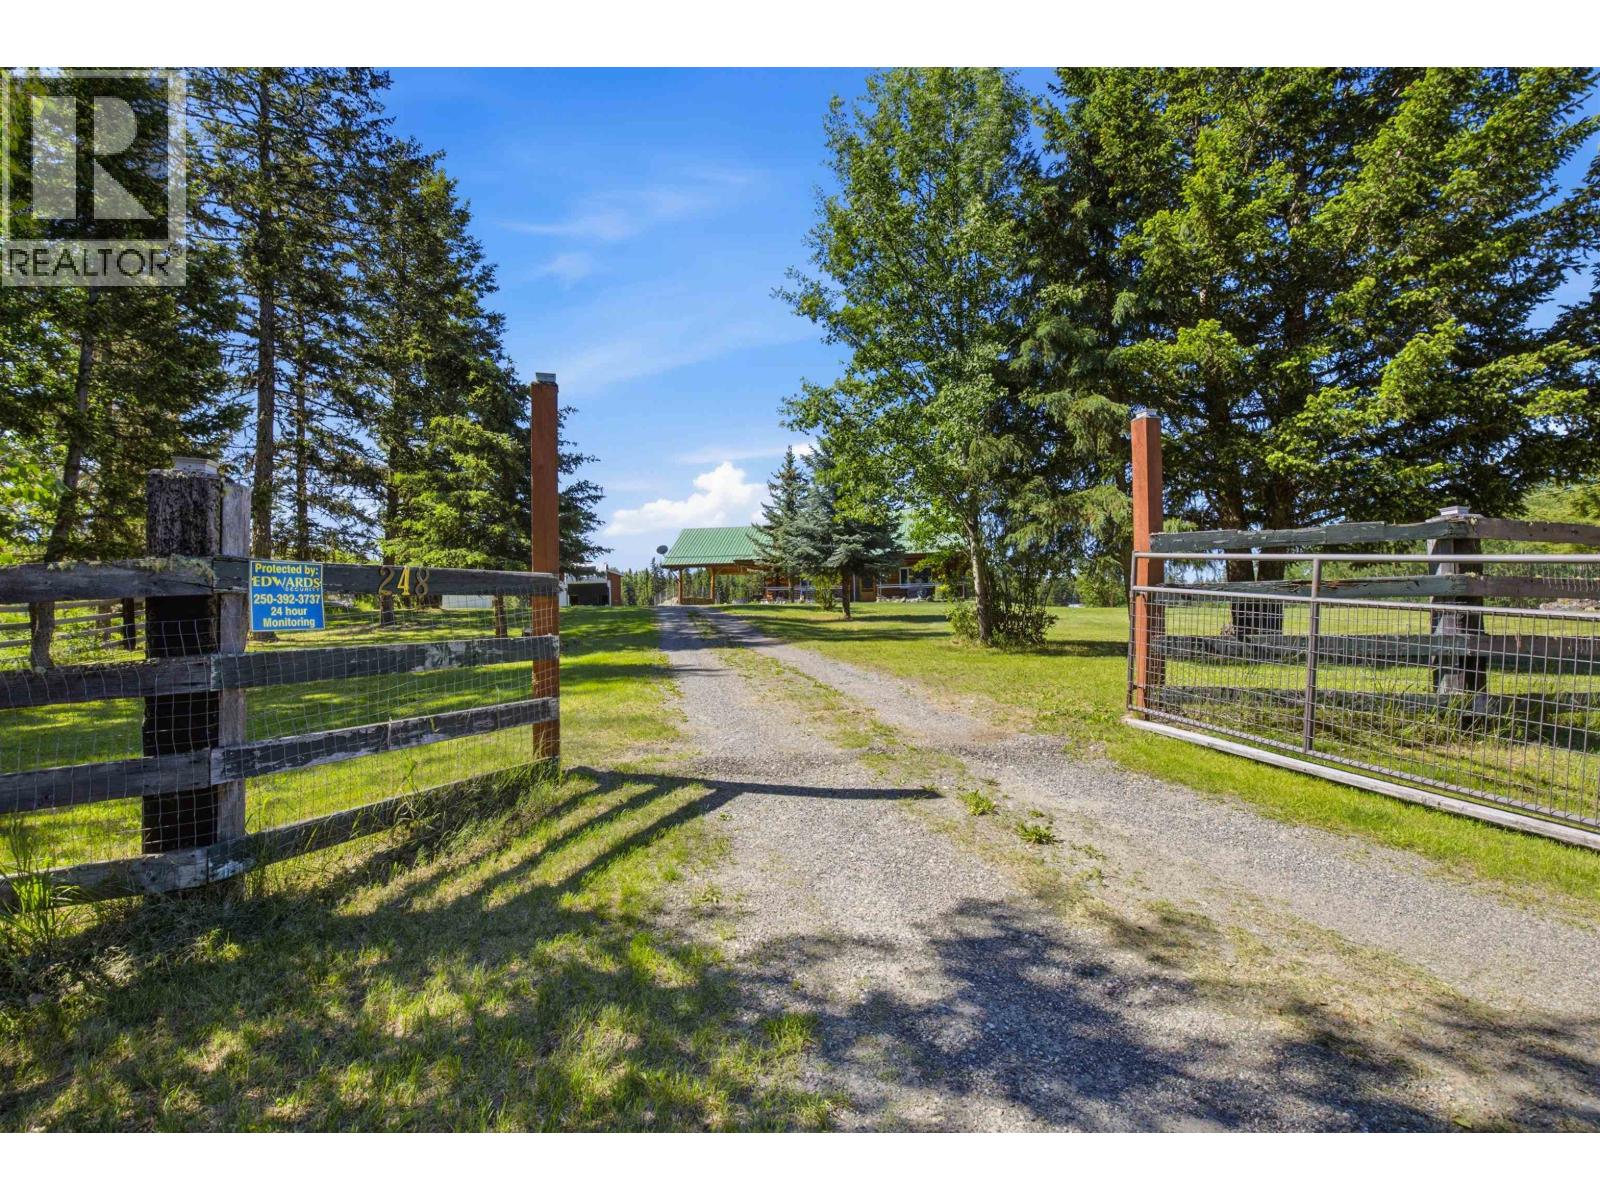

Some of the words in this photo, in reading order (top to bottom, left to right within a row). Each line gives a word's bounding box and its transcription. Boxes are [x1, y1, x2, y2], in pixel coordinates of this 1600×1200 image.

[255, 563, 302, 574] Protected
[304, 565, 319, 576] by:
[252, 576, 321, 589] EDWARDS
[378, 565, 430, 598] 248
[253, 593, 321, 605] 250-392-3737
[271, 606, 283, 616] 24
[285, 606, 308, 616] hour
[263, 617, 316, 628] Monitoring
